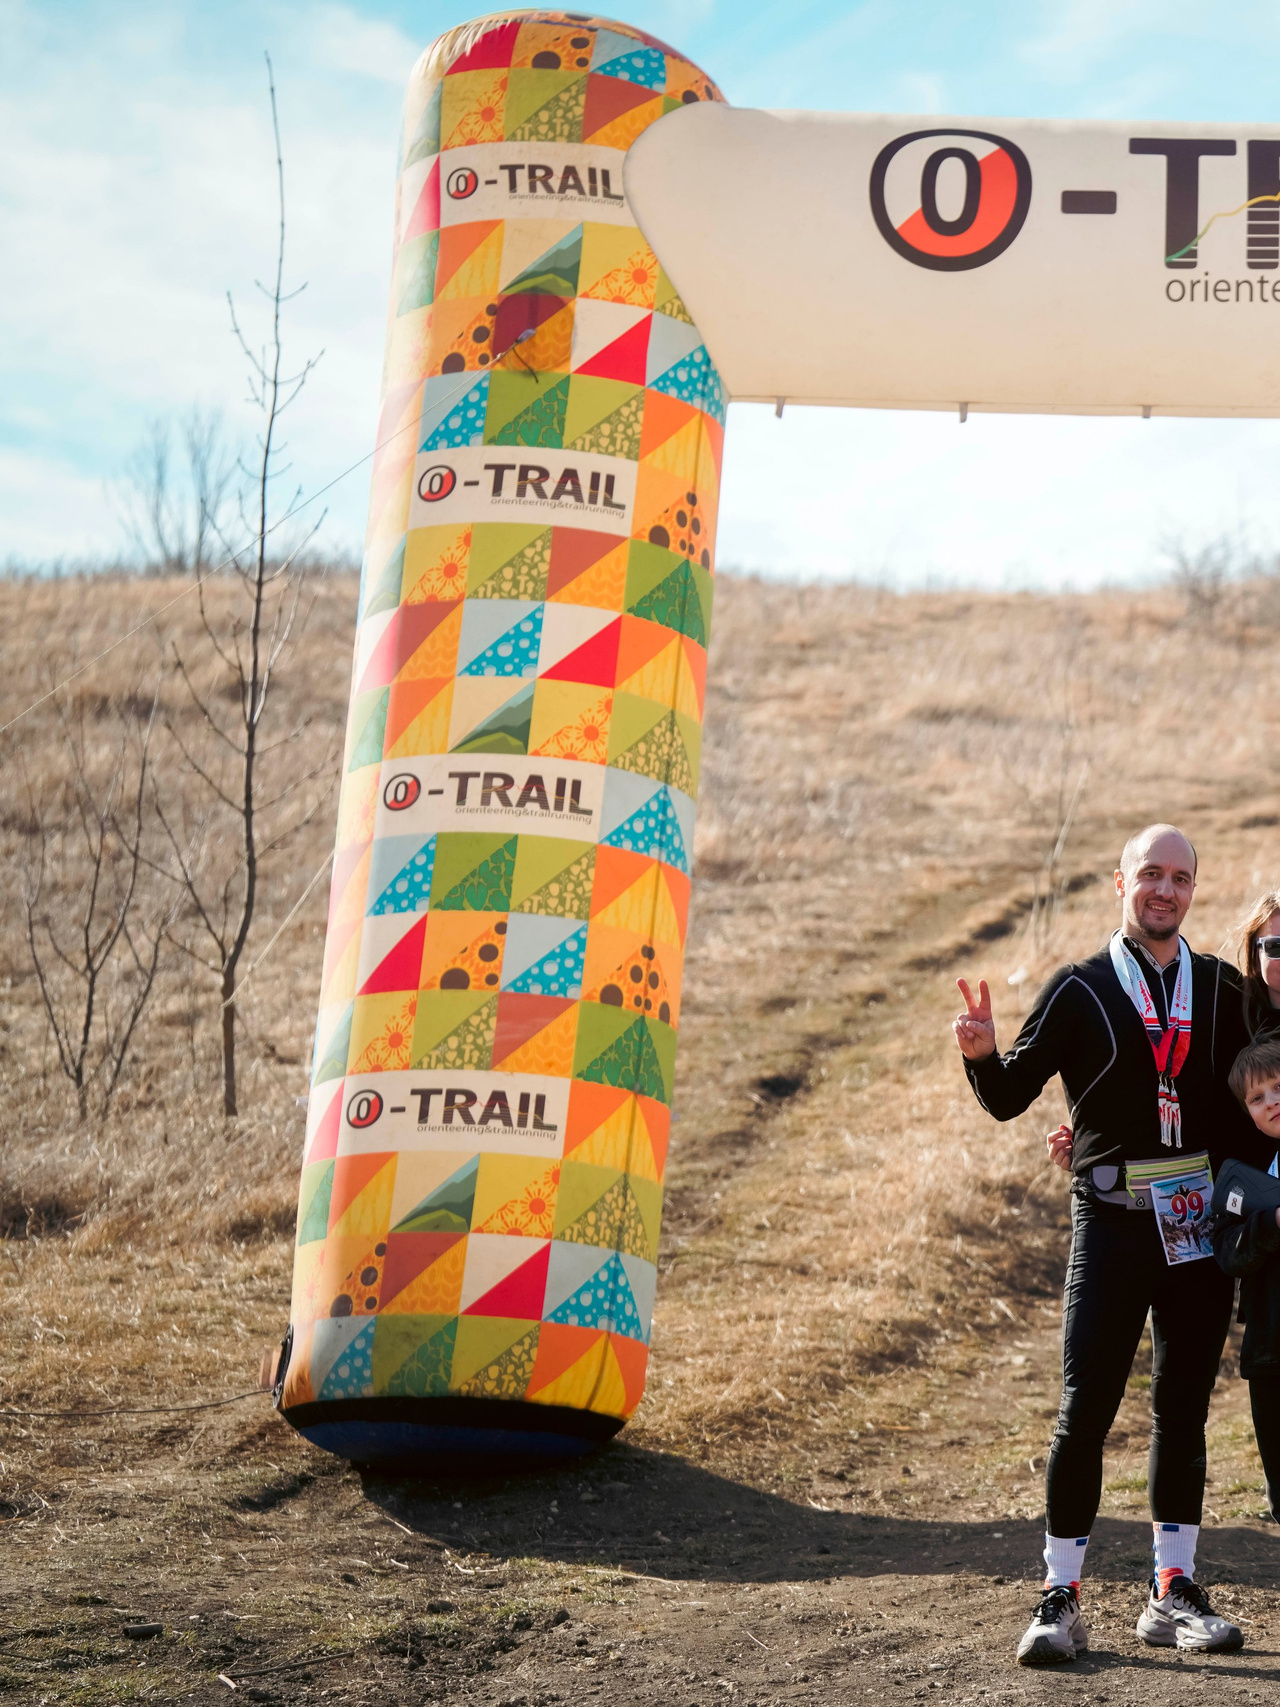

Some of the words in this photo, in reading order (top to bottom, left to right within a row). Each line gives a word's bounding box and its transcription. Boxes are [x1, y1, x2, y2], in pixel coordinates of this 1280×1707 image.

[490, 496, 626, 519] orienteering&trailrunning
[454, 805, 593, 825] orienteering&trailrunning
[416, 1123, 557, 1141] orienteering&trailrunning
[1170, 1190, 1205, 1226] 99
